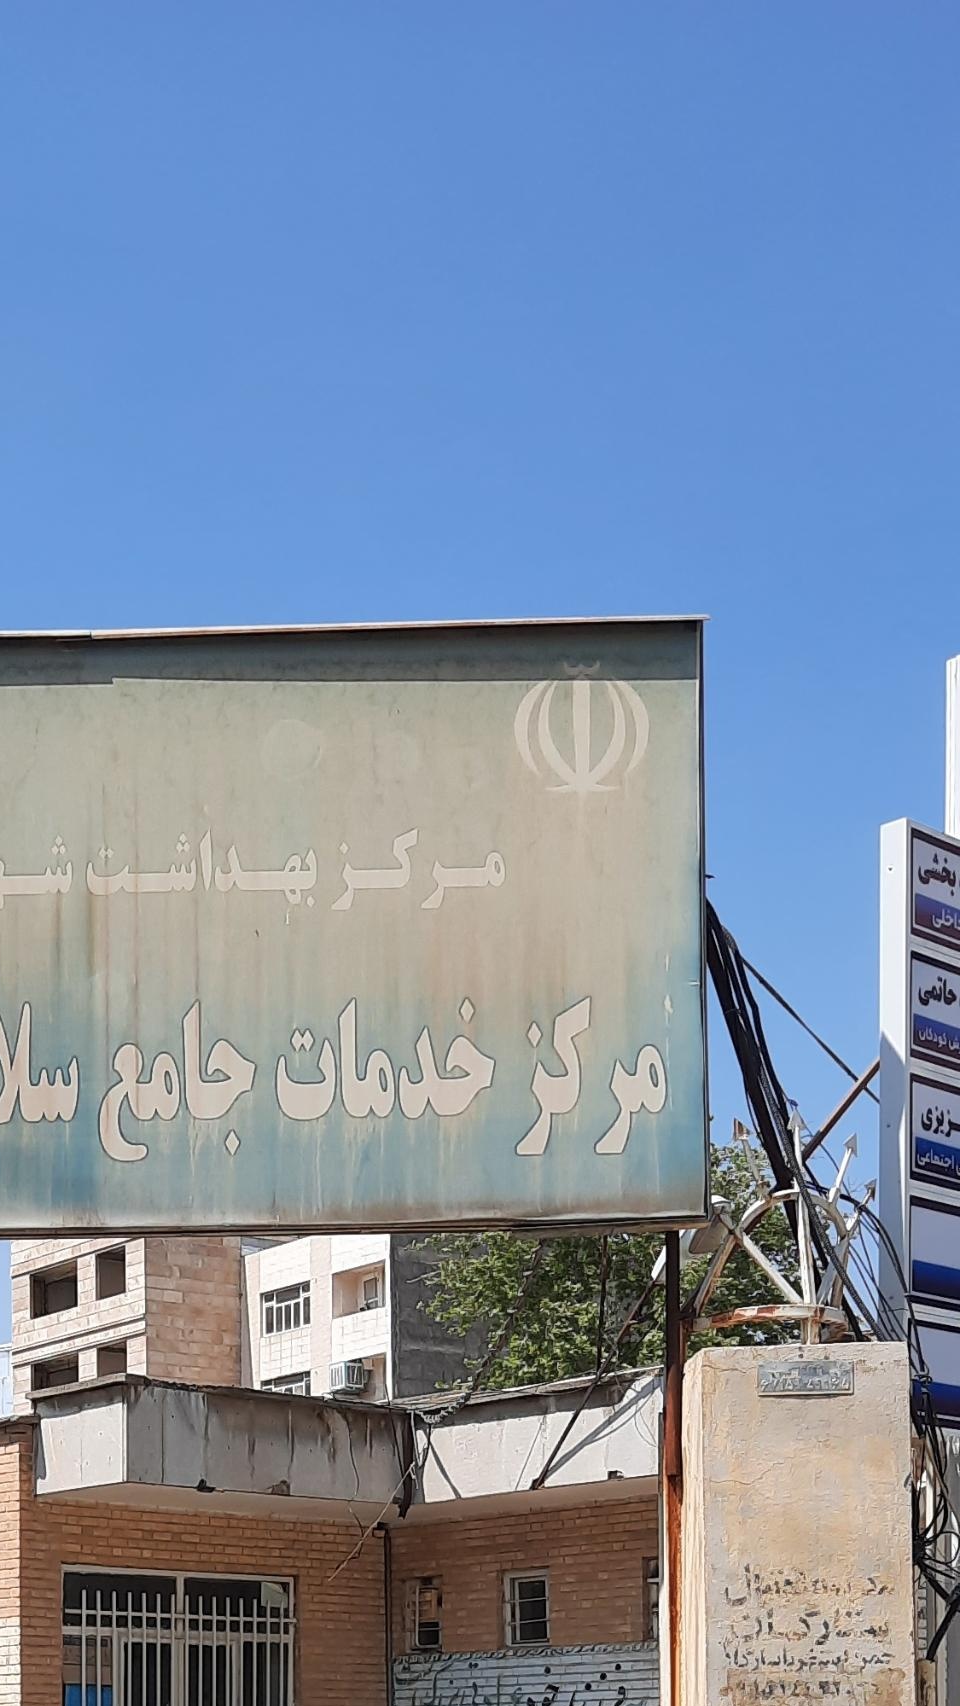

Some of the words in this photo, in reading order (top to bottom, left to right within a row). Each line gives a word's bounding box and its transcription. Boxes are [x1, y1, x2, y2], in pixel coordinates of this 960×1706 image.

[85, 828, 319, 908] بهداشت
[330, 828, 506, 910] مرکز
[918, 975, 958, 1007] حاتمی
[97, 998, 257, 1162] جامع
[275, 996, 497, 1121] خدمات
[515, 996, 668, 1157] مرکز
